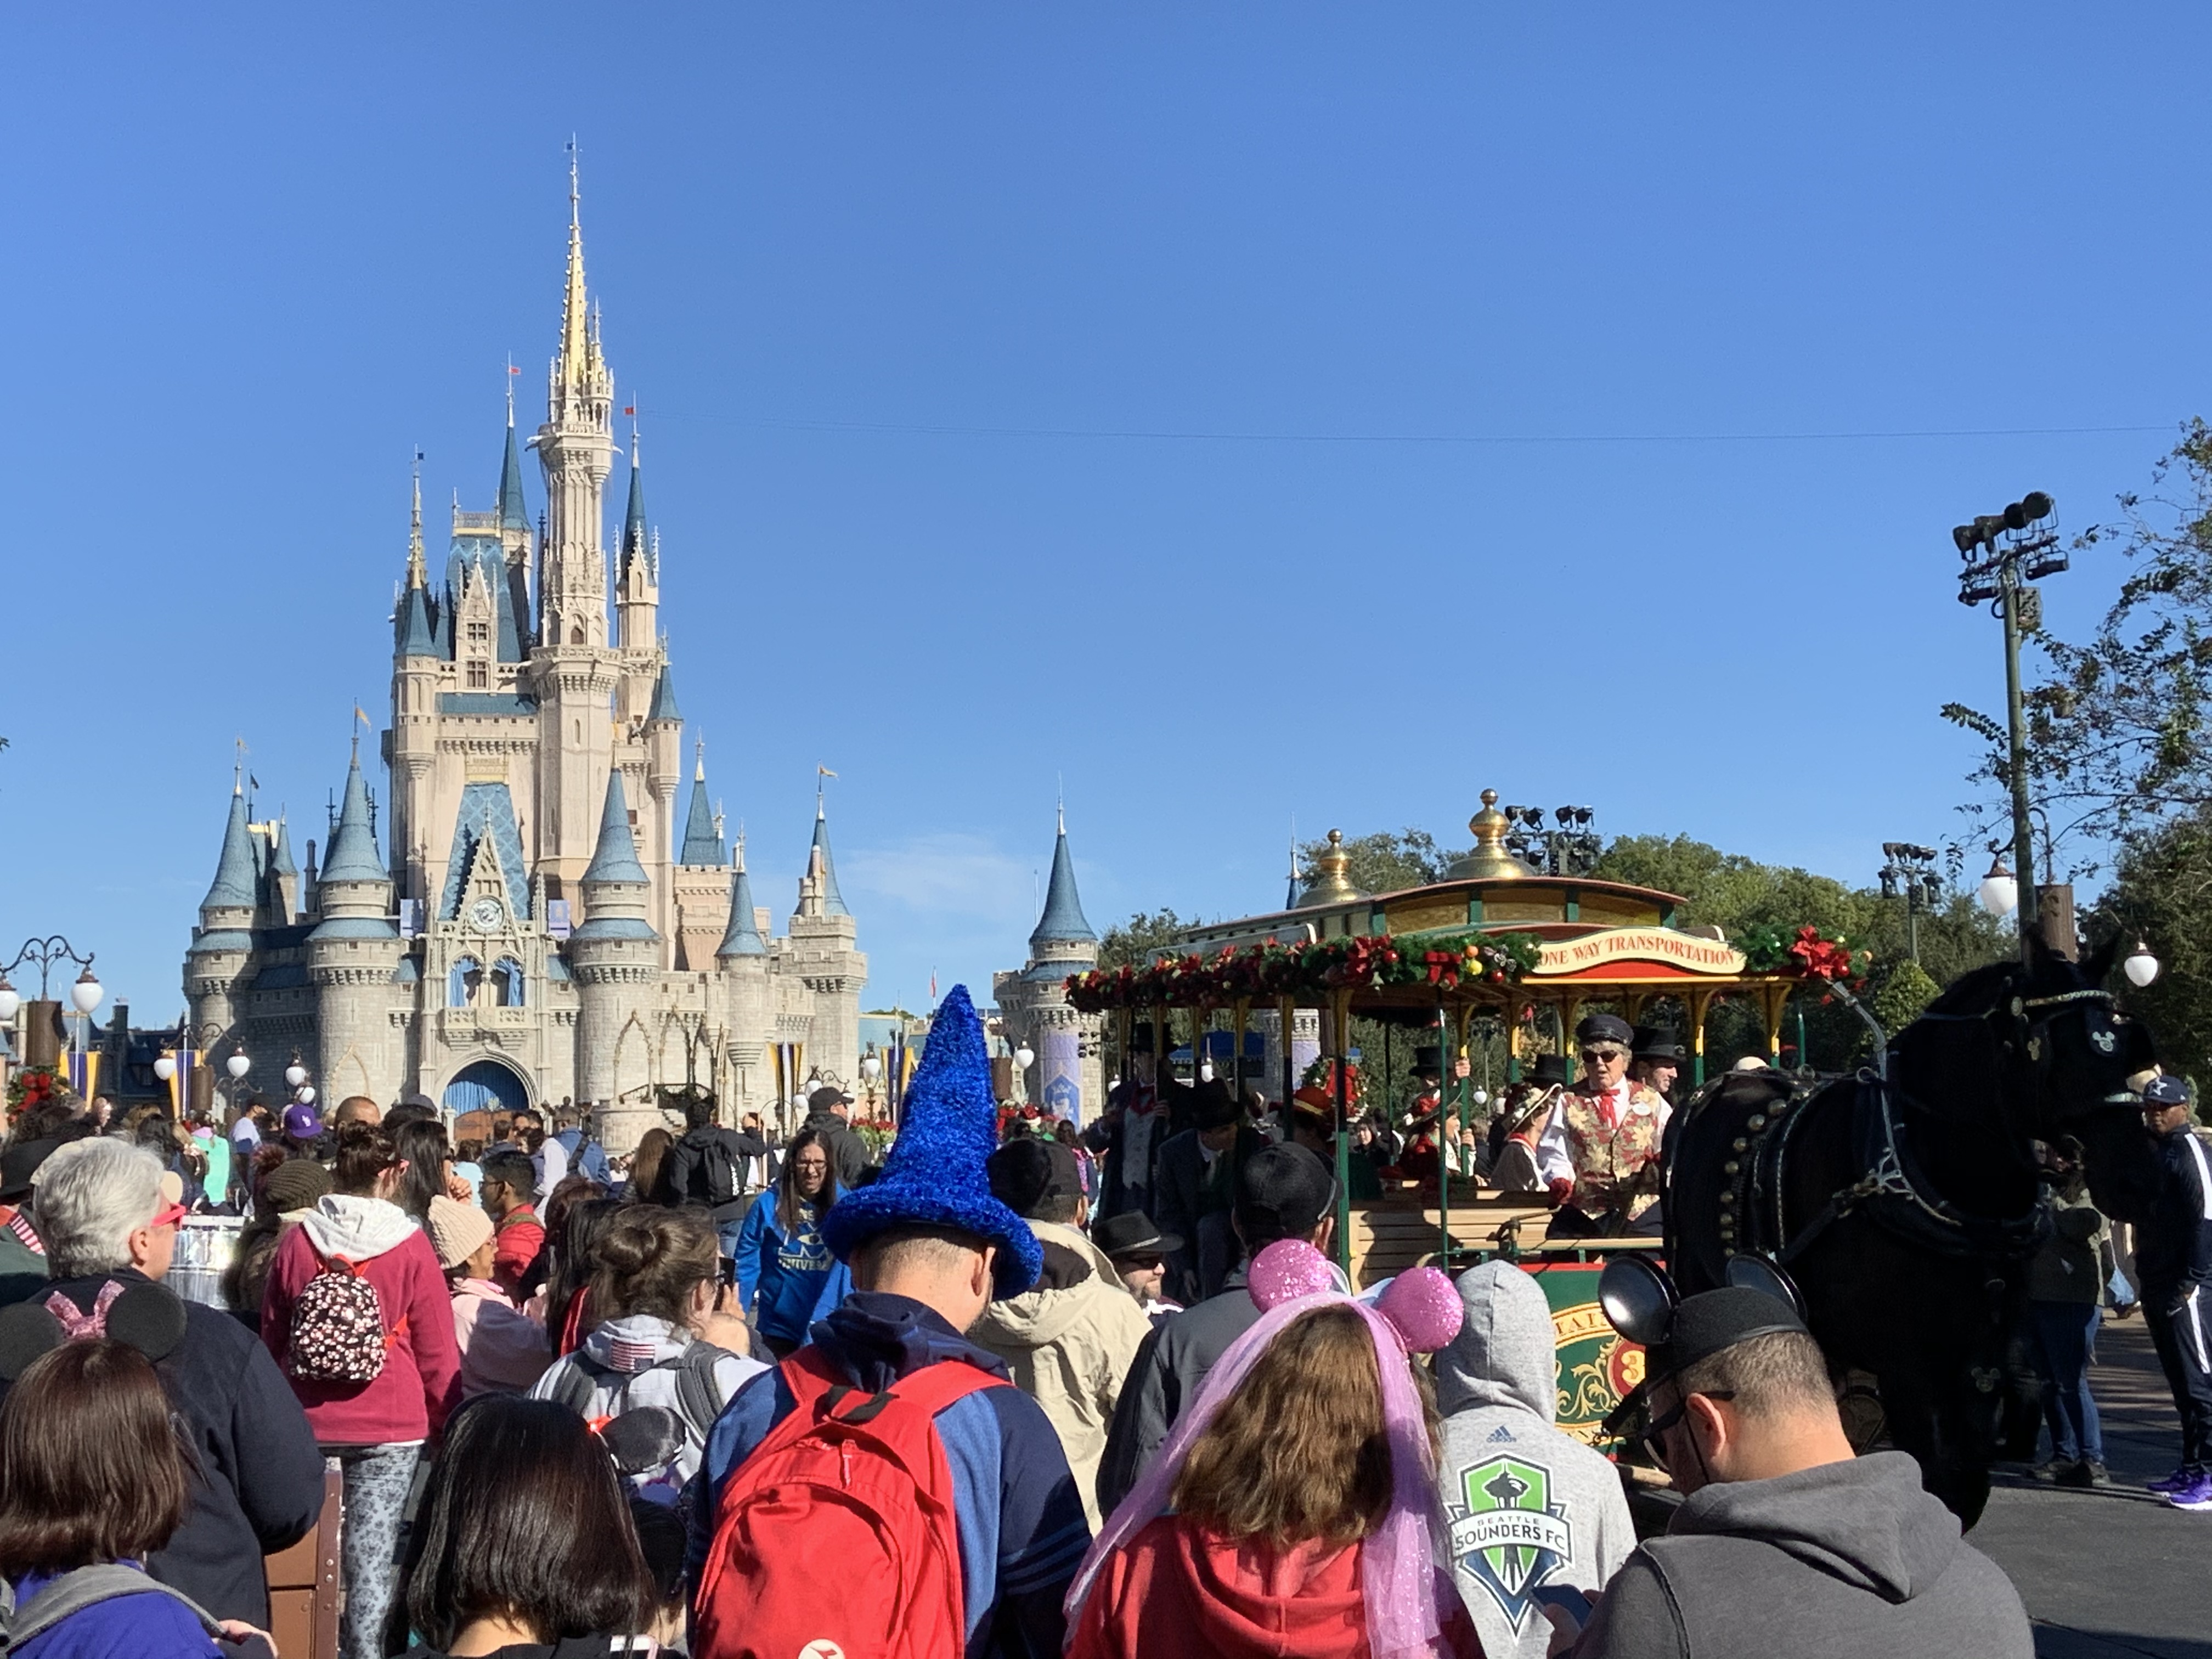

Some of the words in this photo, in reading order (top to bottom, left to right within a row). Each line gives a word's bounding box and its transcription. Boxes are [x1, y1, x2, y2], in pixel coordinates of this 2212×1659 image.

[1541, 950, 1568, 966] ONE
[1572, 940, 1602, 961] WAY
[1605, 935, 1734, 965] TRANSPORTATION
[1477, 1516, 1539, 1526] SEATTLE
[1455, 1524, 1541, 1550] SOUNDERS
[1545, 1529, 1565, 1550] FC
